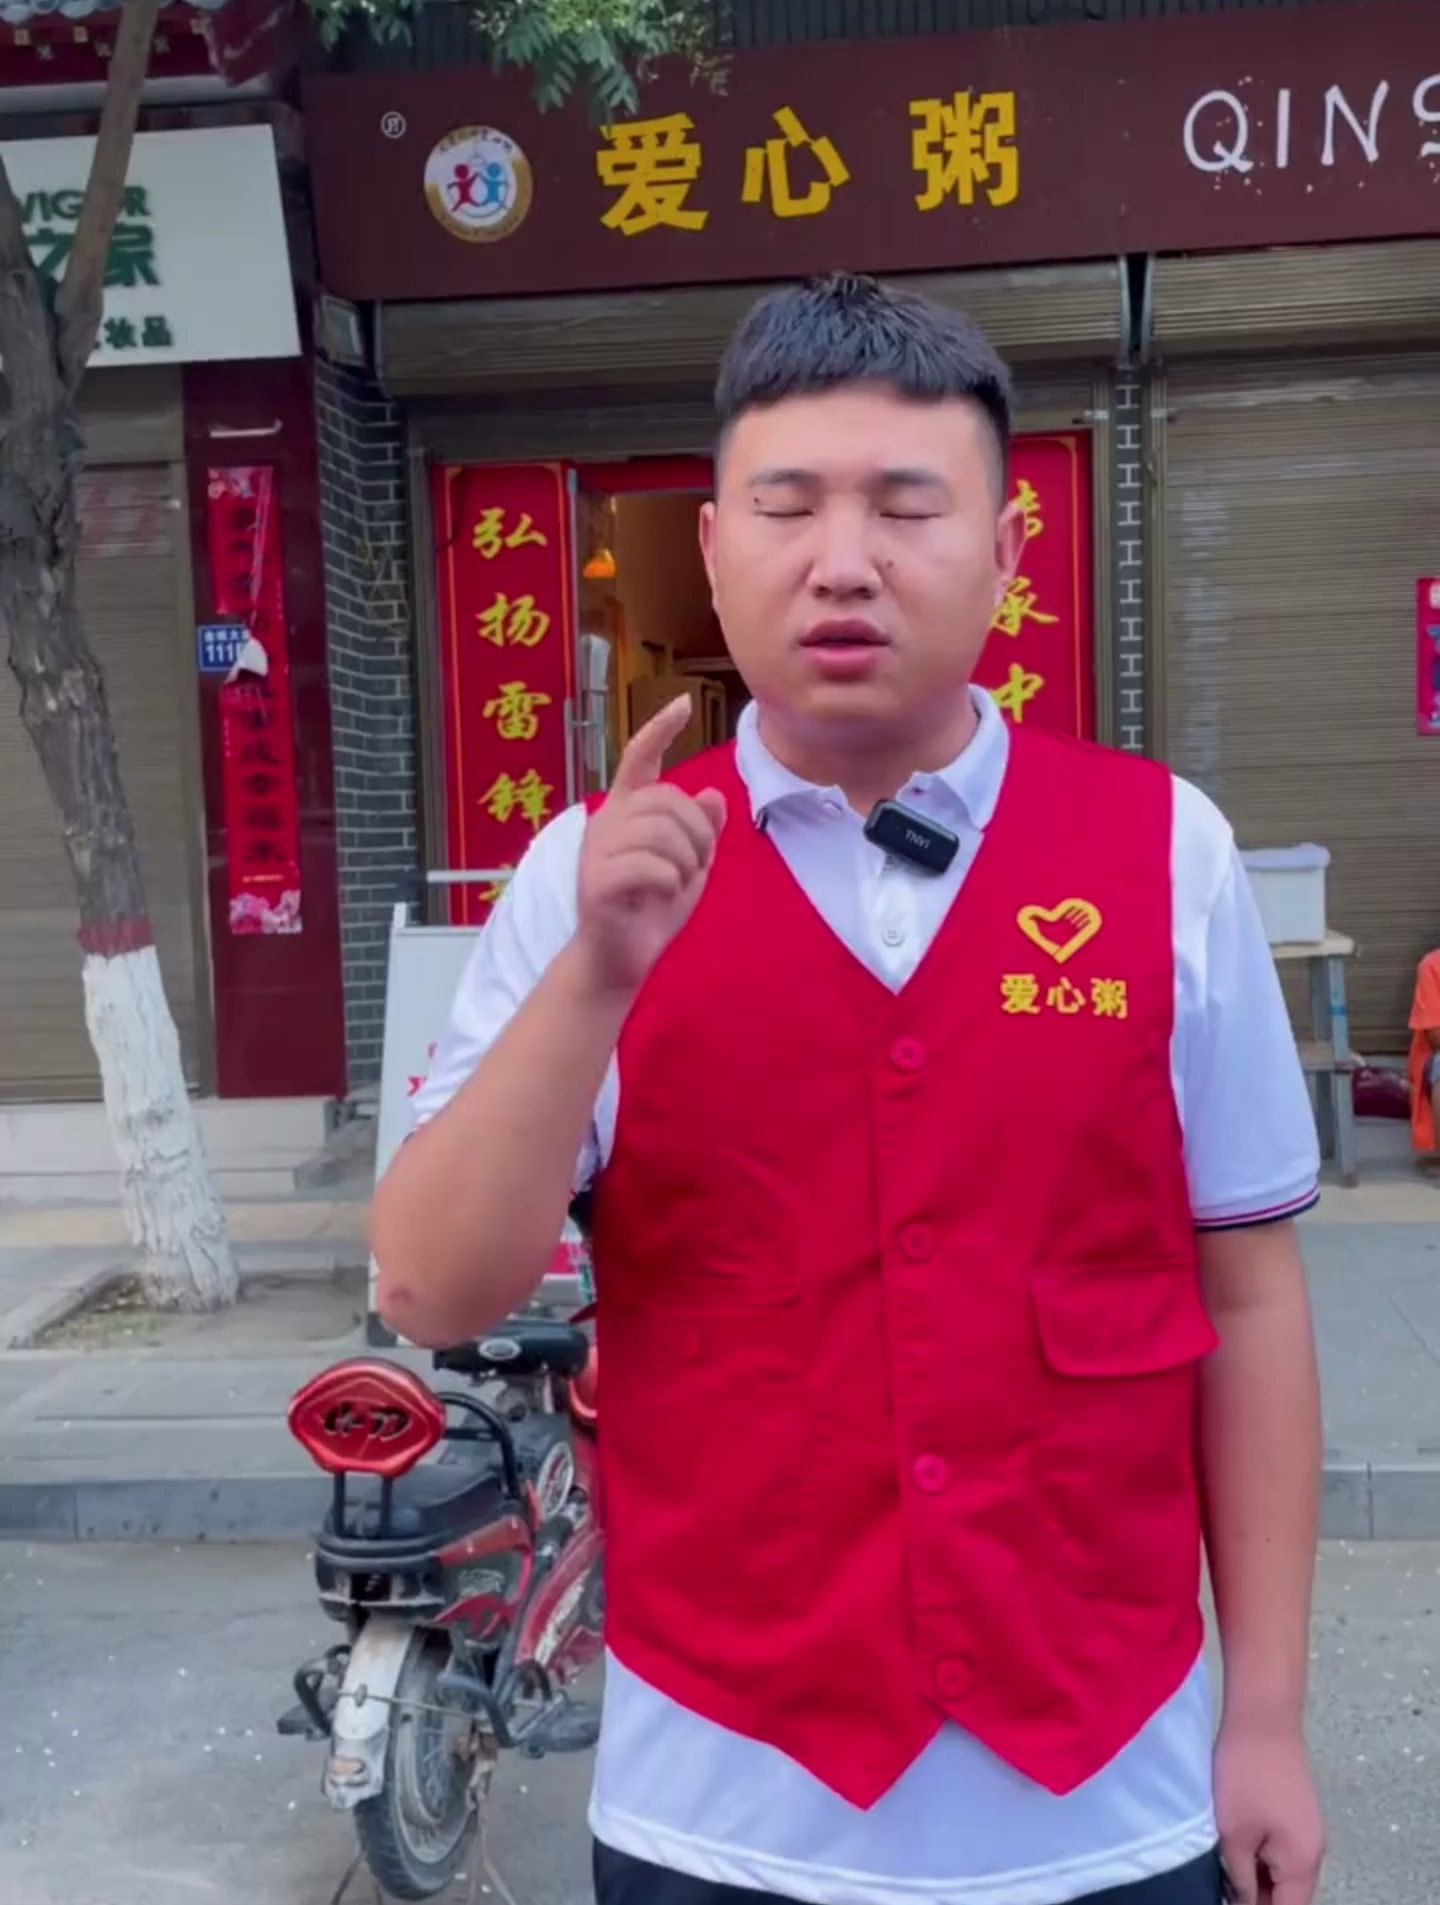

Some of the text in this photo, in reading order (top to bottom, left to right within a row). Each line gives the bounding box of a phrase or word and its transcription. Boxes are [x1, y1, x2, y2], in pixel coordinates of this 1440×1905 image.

[596, 90, 1019, 236] 爱心粥
[1000, 973, 1129, 1020] 爱心粥
